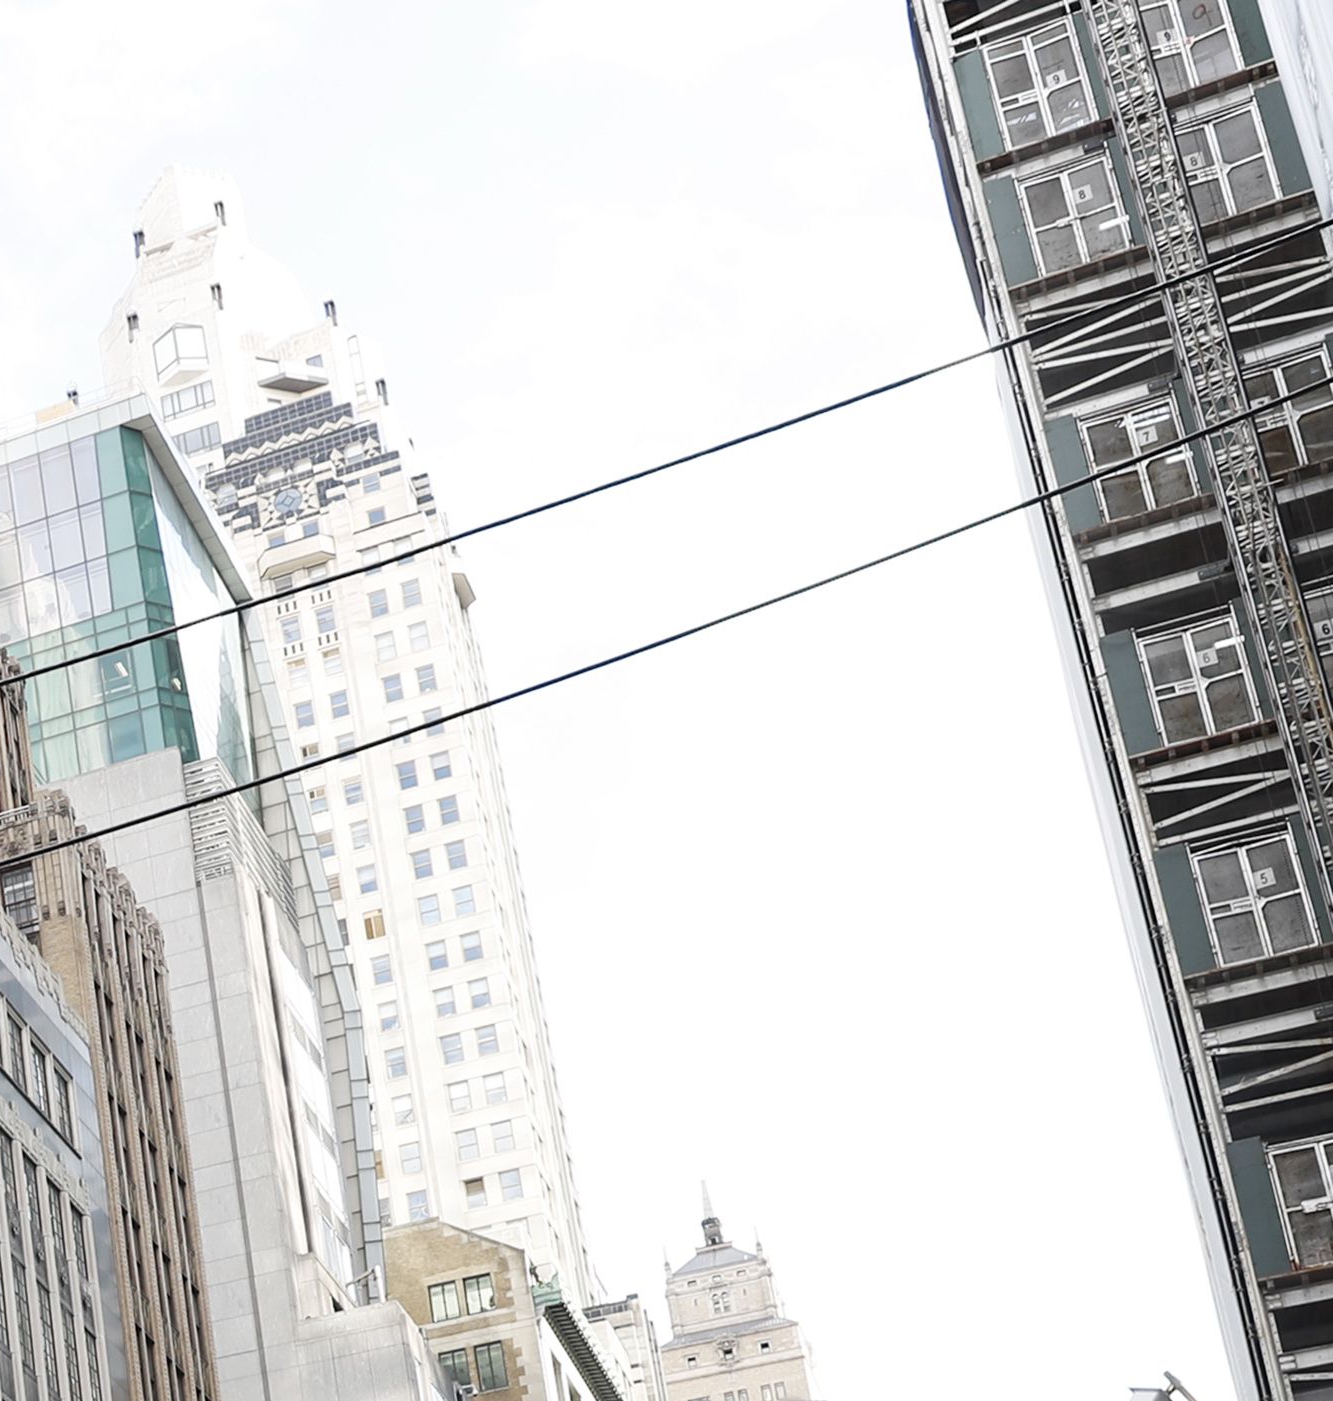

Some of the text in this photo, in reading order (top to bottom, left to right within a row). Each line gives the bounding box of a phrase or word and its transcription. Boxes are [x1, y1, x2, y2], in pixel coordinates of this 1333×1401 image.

[1052, 74, 1061, 85] 9
[1321, 623, 1331, 636] 6
[1259, 872, 1269, 885] 5
